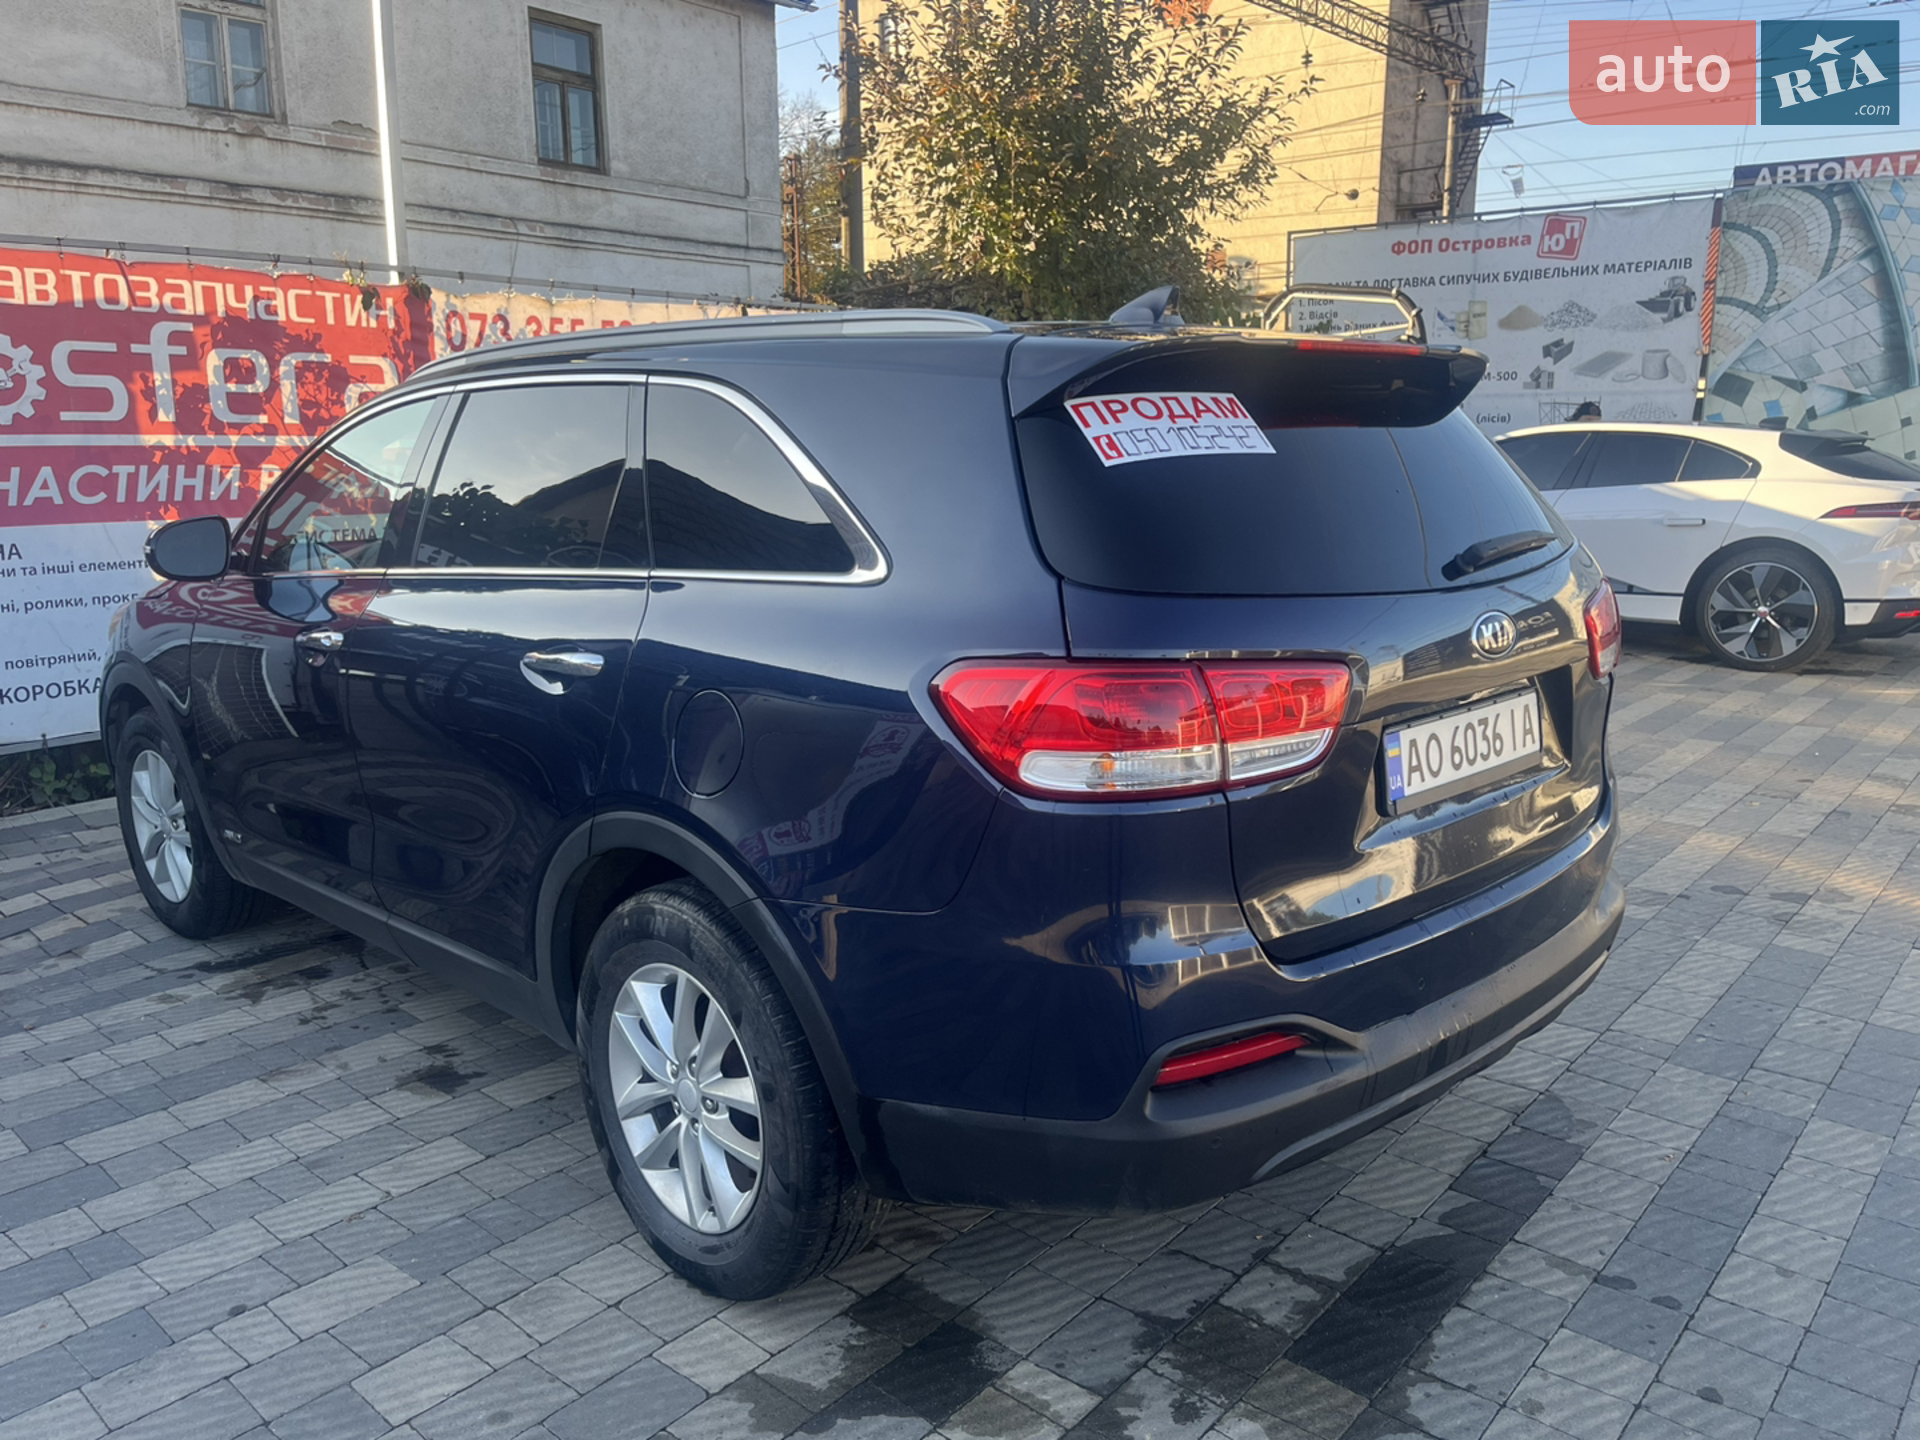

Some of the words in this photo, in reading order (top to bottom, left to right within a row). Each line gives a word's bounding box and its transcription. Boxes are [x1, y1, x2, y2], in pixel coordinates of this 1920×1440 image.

[1391, 239, 1433, 256] ФОП
[1437, 234, 1532, 253] Островка
[1439, 272, 1500, 287] СИПУЧИХ
[1503, 264, 1600, 283] БУДІВЕЛЬНИХ
[1602, 257, 1693, 275] МАТЕРІАЛІВ
[1298, 312, 1307, 320] 2.
[1309, 310, 1338, 320] Відсів
[446, 309, 512, 352] 073
[1070, 396, 1249, 429] ПРОДАМ
[1476, 413, 1511, 424] (лісів)
[21, 565, 37, 576] та
[42, 561, 75, 575] інші
[24, 597, 88, 614] ролики,
[1480, 619, 1513, 650] KIA
[4, 648, 101, 670] повітряний,
[0, 677, 101, 705] КОРОБКА
[1408, 732, 1443, 788] AO
[1450, 712, 1504, 771] 6036
[1511, 703, 1536, 752] IA
[1390, 775, 1403, 790] UA
